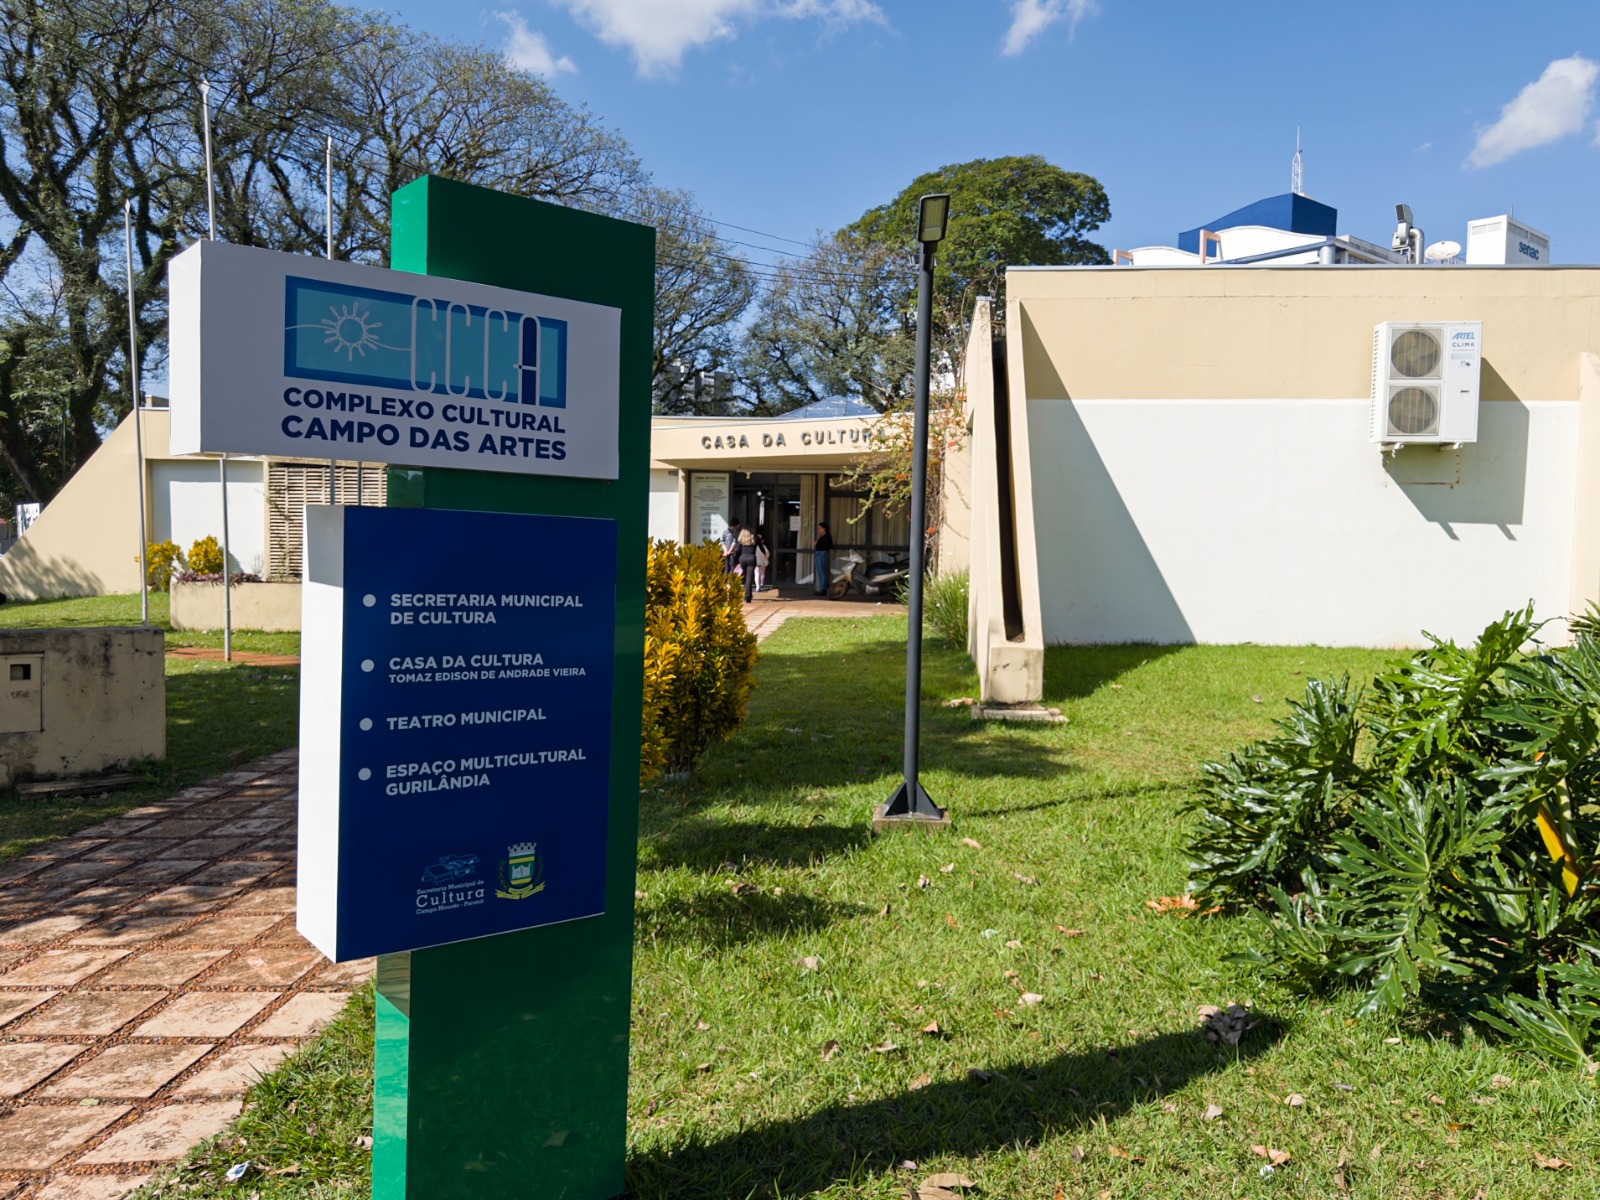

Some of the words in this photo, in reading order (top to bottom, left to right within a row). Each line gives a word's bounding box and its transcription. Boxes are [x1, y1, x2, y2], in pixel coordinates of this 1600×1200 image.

[1519, 241, 1539, 261] senac
[1452, 332, 1475, 340] ARTEL
[411, 295, 541, 405] CCCA
[283, 387, 434, 420] COMPLEXO
[442, 403, 566, 433] CULTURAL
[281, 415, 400, 446] CAMPO
[409, 426, 470, 451] DAS
[478, 433, 567, 461] ARTES
[701, 433, 750, 450] CASA
[762, 432, 787, 448] DA
[390, 594, 497, 607] SECRETARIA
[501, 595, 583, 608] MUNICIPAL
[390, 612, 414, 625] DE
[418, 611, 496, 624] CULTURA
[389, 656, 437, 670] CASA
[442, 655, 466, 668] DA
[470, 653, 544, 667] CULTURA
[389, 673, 432, 683] TOMAZ
[435, 671, 478, 682] EDISON
[481, 670, 496, 680] DE
[498, 668, 550, 679] ANDRADE
[553, 667, 586, 677] VIEIRA
[387, 713, 456, 730] TEATRO
[461, 708, 546, 725] MUNICIPAL
[386, 759, 456, 778] ESPAÇO
[461, 749, 586, 771] MULTICULTURAL
[385, 773, 490, 796] GURILÂNDIA
[416, 886, 447, 895] Secretaria
[448, 880, 476, 889] Municipal
[416, 888, 485, 908] Cultura
